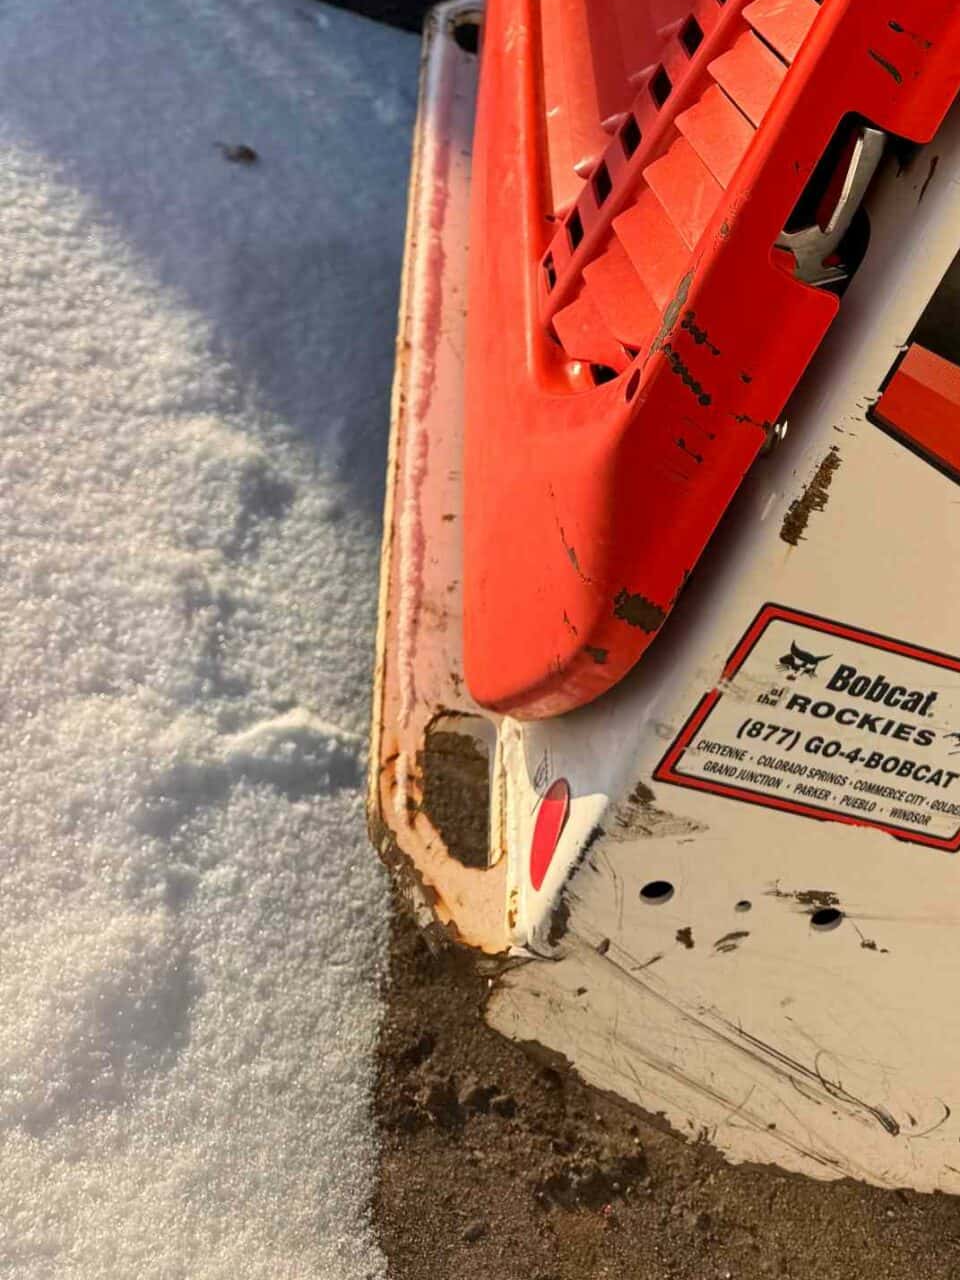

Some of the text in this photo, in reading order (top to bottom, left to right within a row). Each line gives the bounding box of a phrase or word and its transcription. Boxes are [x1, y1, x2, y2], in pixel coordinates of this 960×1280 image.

[756, 693, 779, 707] the
[785, 693, 937, 746] ROCKIES
[826, 663, 939, 717] Bobcat
[697, 739, 748, 761] CHEYENNE
[757, 755, 808, 776] COLORADO
[806, 767, 849, 786] SPRINGS
[852, 779, 906, 801] COMMERCE
[904, 792, 928, 807] CITY
[736, 718, 960, 789] (877) GO-4-BOBCAT
[703, 760, 933, 827] GRAND JUNCTION PARKER PUEBLO WINDSOR
